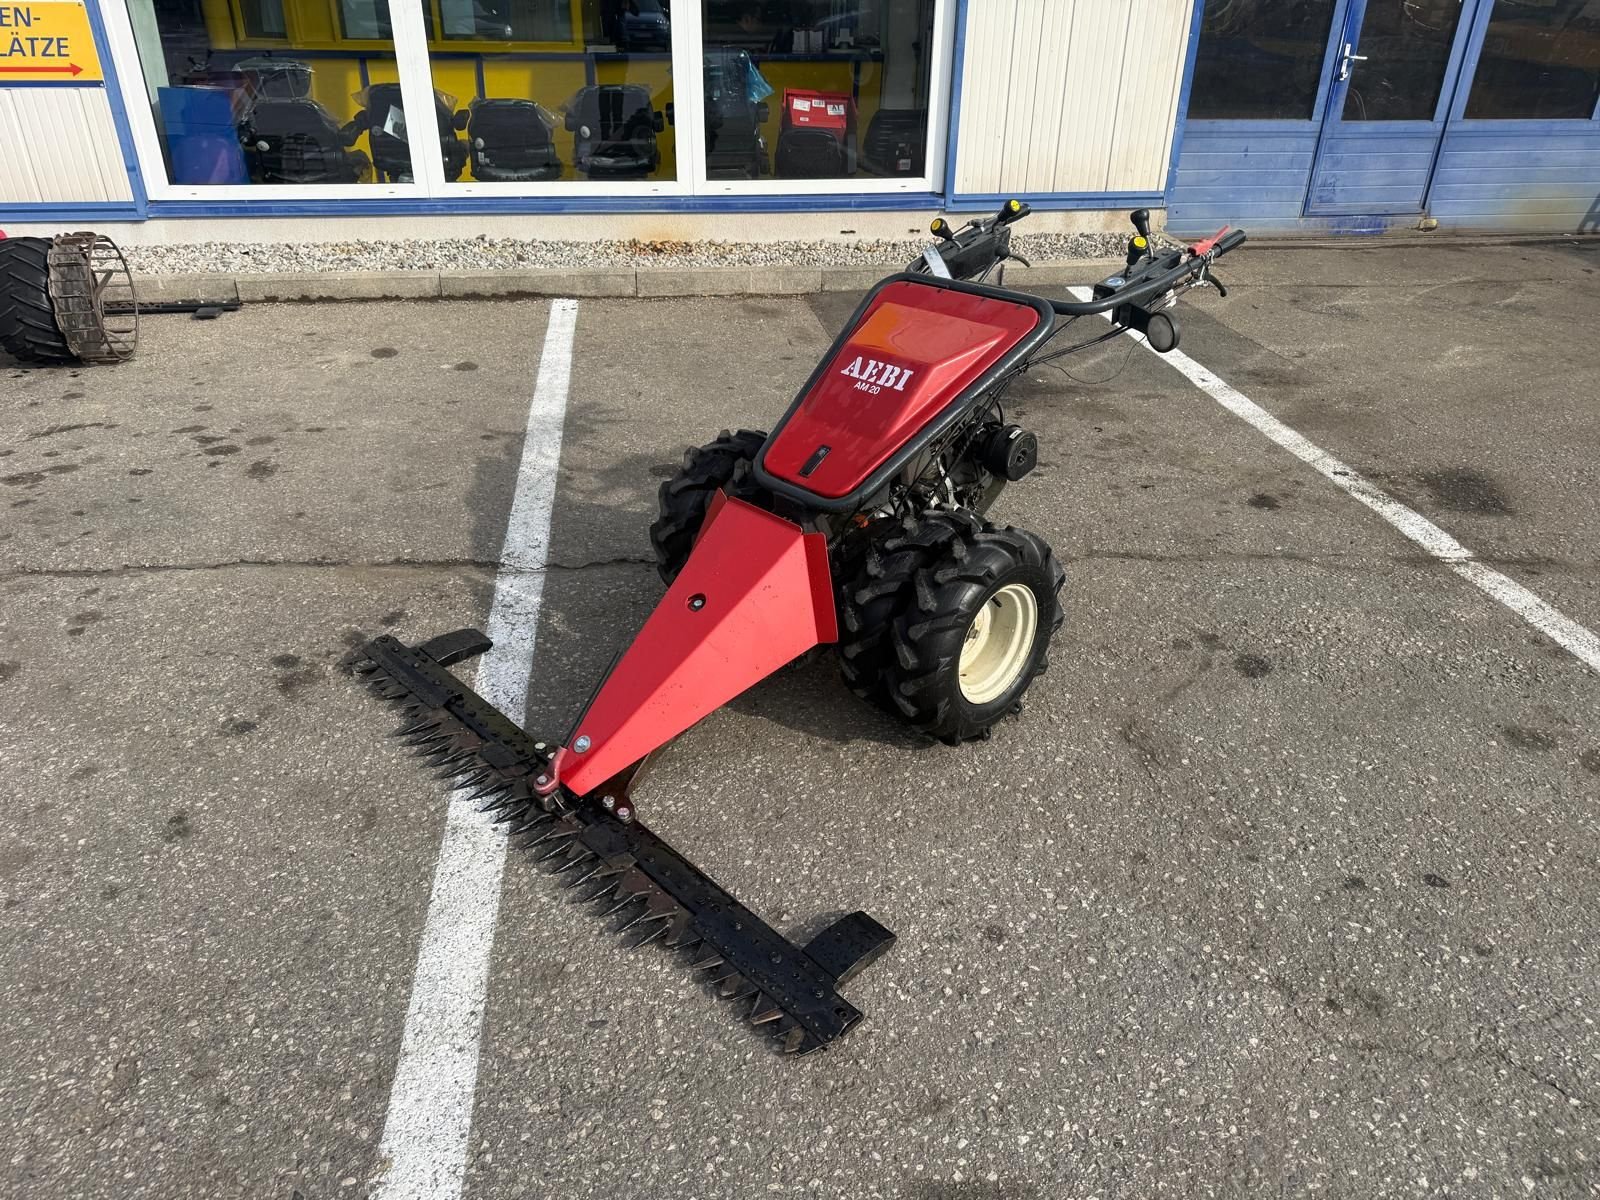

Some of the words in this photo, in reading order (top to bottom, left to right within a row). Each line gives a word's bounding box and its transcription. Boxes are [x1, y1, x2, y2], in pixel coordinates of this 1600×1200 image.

[0, 7, 41, 27] EN-
[840, 356, 914, 391] AEBI
[854, 381, 870, 392] AM
[868, 385, 880, 395] 20
